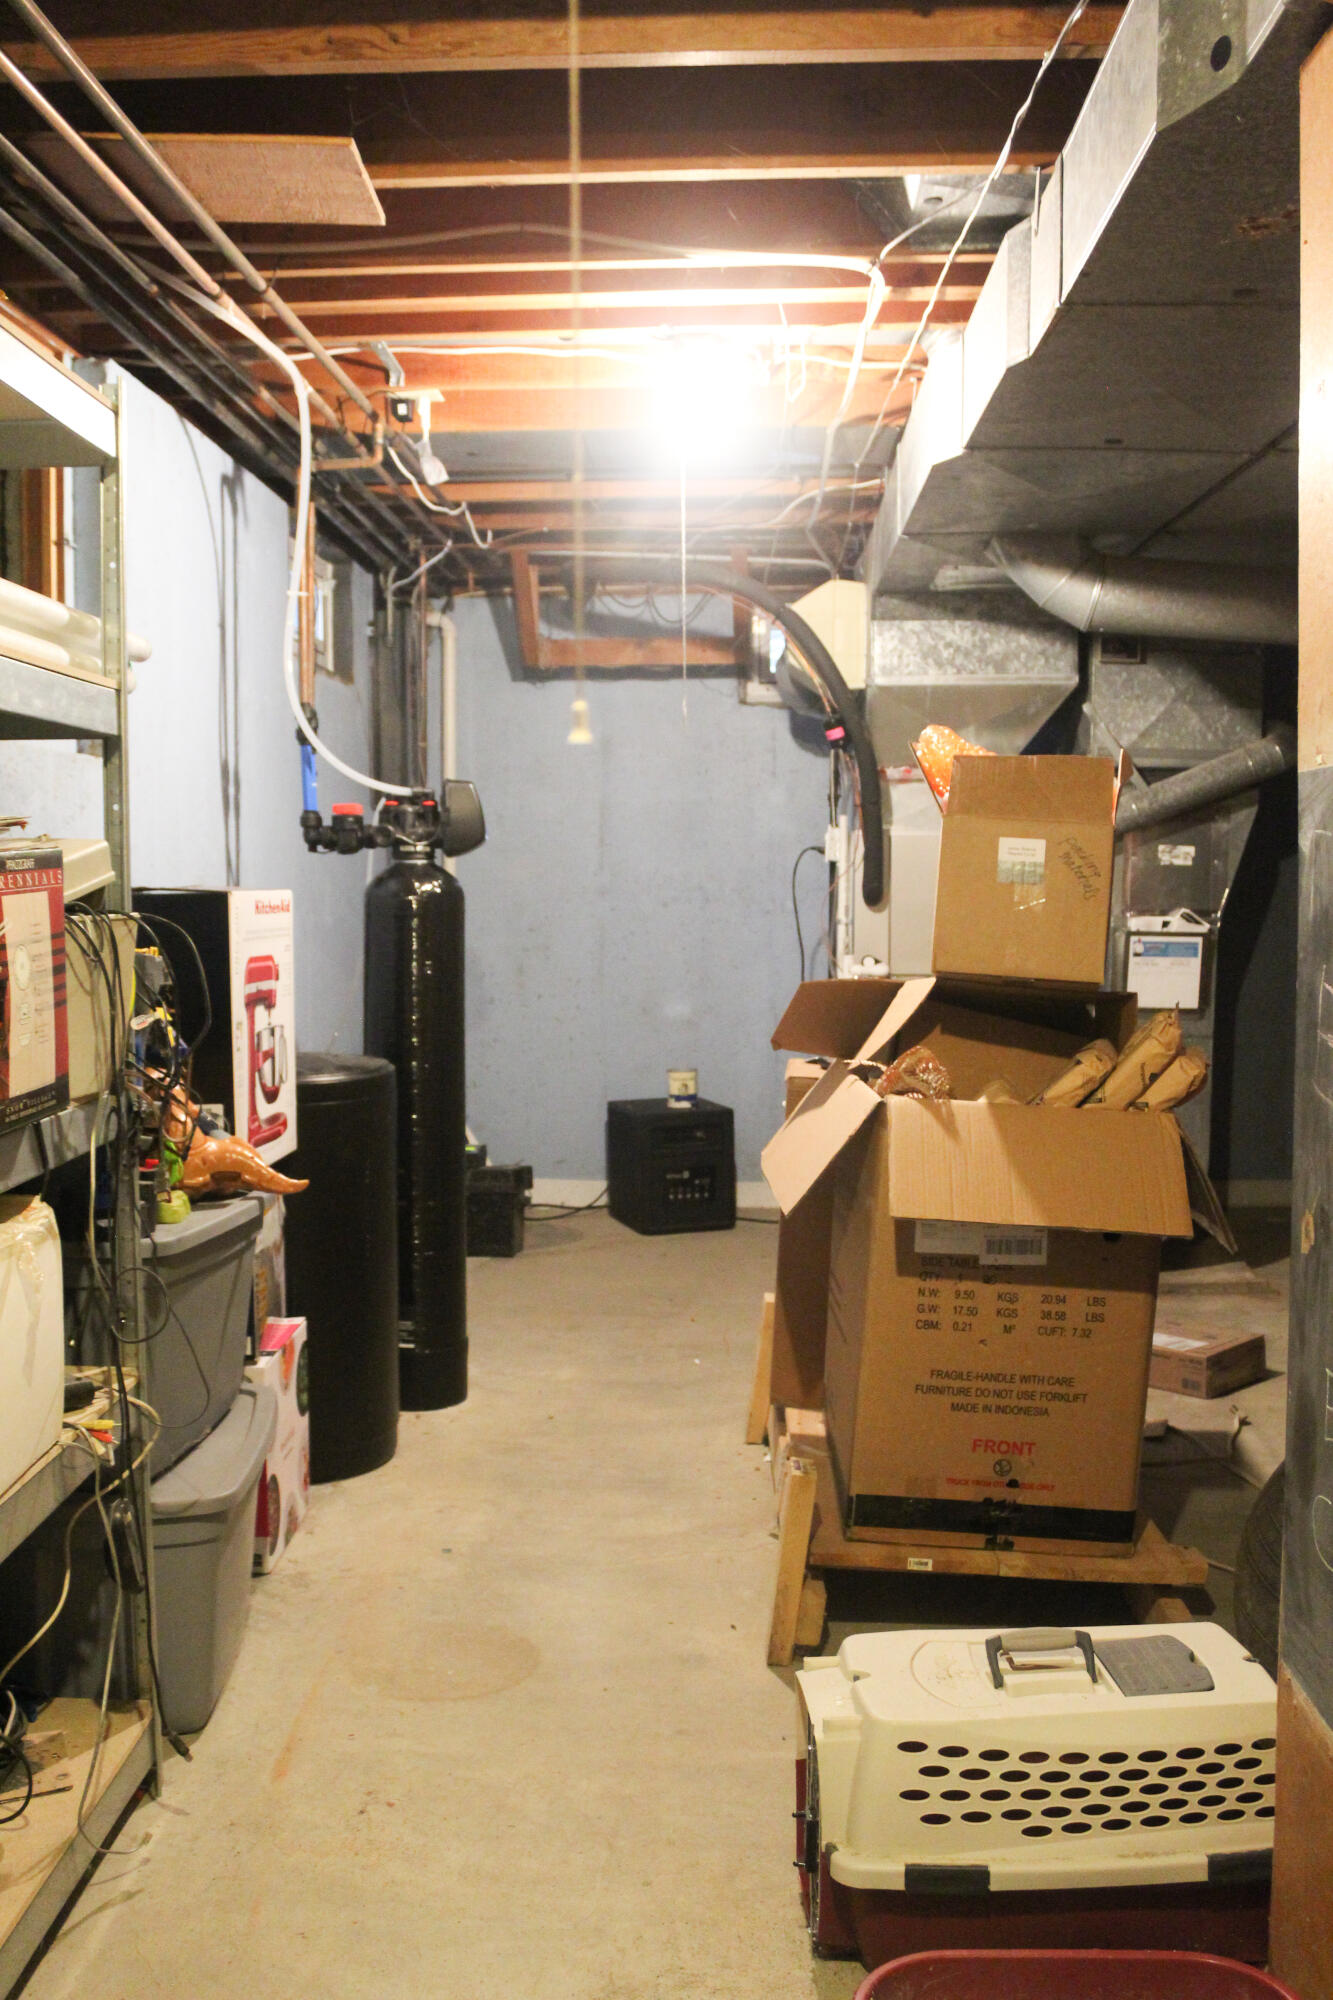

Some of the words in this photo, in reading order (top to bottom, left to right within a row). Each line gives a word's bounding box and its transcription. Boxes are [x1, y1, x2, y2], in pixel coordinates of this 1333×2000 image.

[255, 899, 291, 914] KitchenAid
[954, 1289, 976, 1301] 9.50
[997, 1292, 1020, 1304] KGS
[1040, 1294, 1067, 1305] 20.94
[1086, 1296, 1107, 1308] LBS
[953, 1305, 979, 1317] 17.50
[996, 1308, 1019, 1319] KGS
[1085, 1312, 1105, 1323] LBS
[952, 1321, 973, 1333] 0.21
[1071, 1327, 1093, 1338] 7.32
[1019, 1374, 1046, 1386] WITH
[1046, 1376, 1076, 1388] CARE
[914, 1384, 973, 1397] FURNITURE
[975, 1388, 991, 1399] DO
[993, 1389, 1015, 1400] NOT
[1016, 1391, 1037, 1401] USE
[1039, 1391, 1088, 1404] FORKLIFT
[951, 1402, 980, 1414] MADE
[982, 1405, 993, 1414] IN
[995, 1406, 1050, 1417] INDONESIA
[971, 1438, 1037, 1457] FRONT
